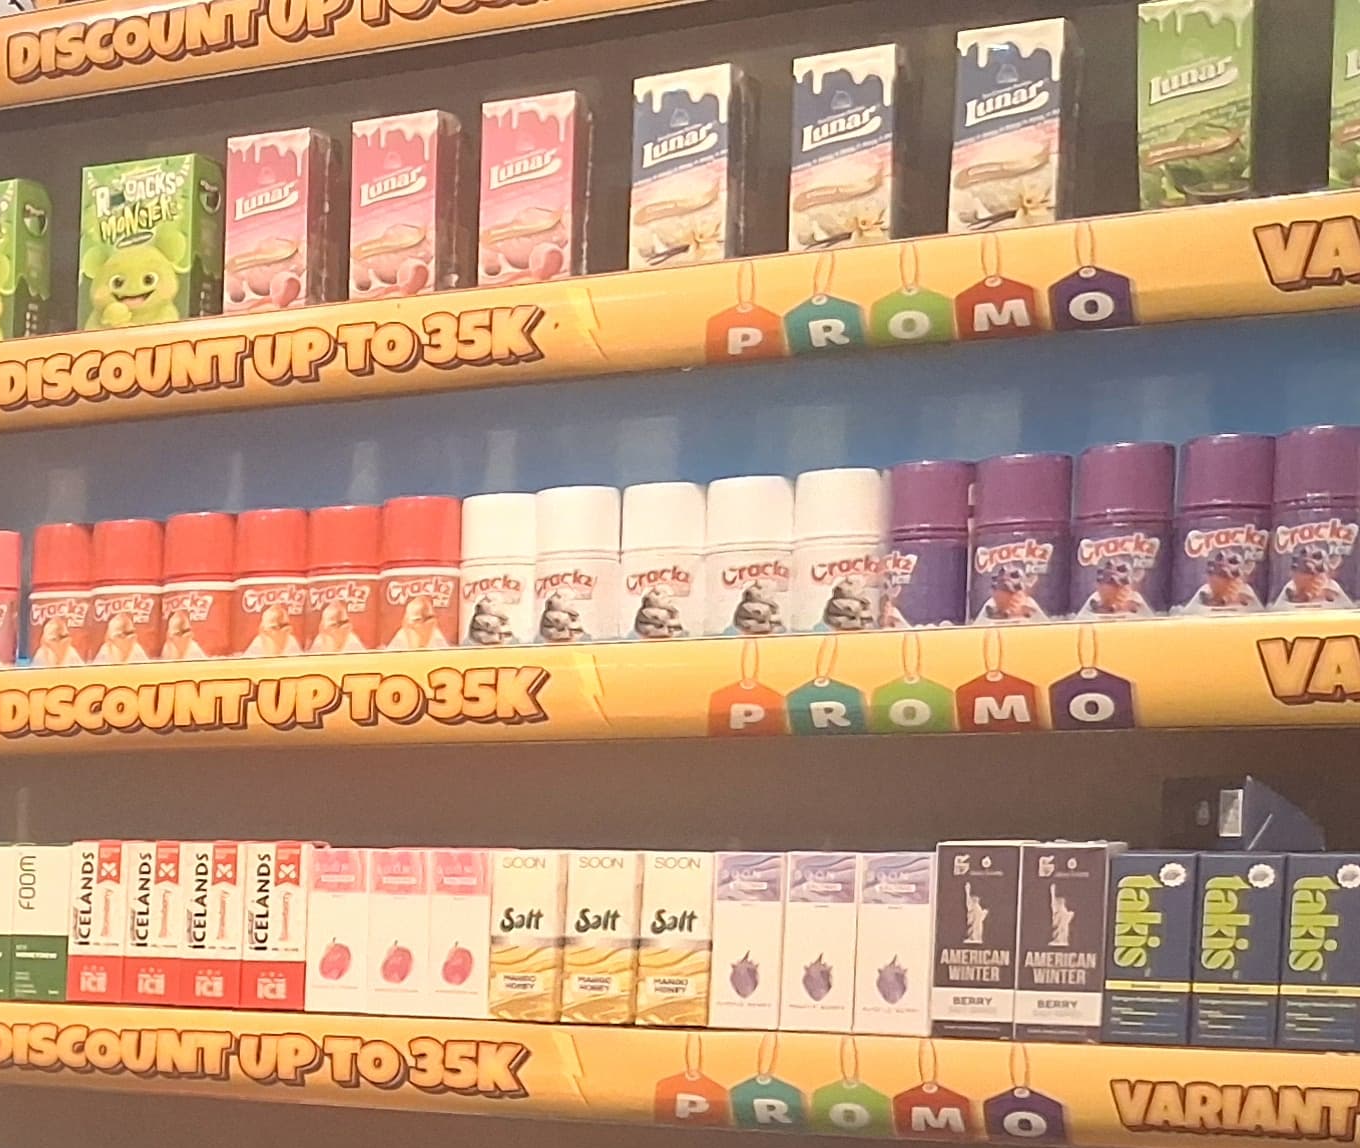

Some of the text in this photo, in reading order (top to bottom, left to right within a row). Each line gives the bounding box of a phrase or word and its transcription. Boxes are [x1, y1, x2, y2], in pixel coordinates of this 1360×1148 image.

[7, 0, 259, 82] DISCOUNT
[964, 79, 1049, 128] Lunar
[1149, 55, 1238, 104] Lunar
[642, 121, 718, 169] Lunar
[801, 105, 882, 153] Lunar
[360, 162, 427, 208] Lunar
[489, 149, 561, 190] Lunar
[233, 180, 299, 223] Lunar
[253, 323, 336, 386] UP
[337, 320, 423, 377] TO
[423, 305, 545, 365] 35K
[726, 290, 1115, 356] PROMO
[255, 675, 342, 729] UP
[342, 672, 427, 726] TO
[426, 666, 551, 722] 35K
[729, 692, 1116, 730] PROMO
[18, 856, 36, 910] FOOM
[502, 857, 546, 870] SOON
[579, 857, 624, 870] SOON
[654, 857, 700, 870] SOON
[79, 852, 95, 945] ICELANDS
[136, 853, 152, 947] ICELANDS
[193, 853, 209, 948] ICELANDS
[254, 853, 271, 950] ICELANDS
[940, 949, 1009, 967] AMERICAN
[948, 965, 1000, 982] WINTER
[1024, 951, 1096, 969] AMERICAN
[1033, 968, 1086, 985] WINTER
[953, 996, 993, 1007] BERRY
[1037, 998, 1077, 1009] BERRY
[237, 1031, 322, 1086] UP
[322, 1036, 408, 1089] TO
[409, 1037, 530, 1098] 35K
[674, 1093, 1049, 1138] PROMO
[1110, 1079, 1359, 1142] VARIANT
